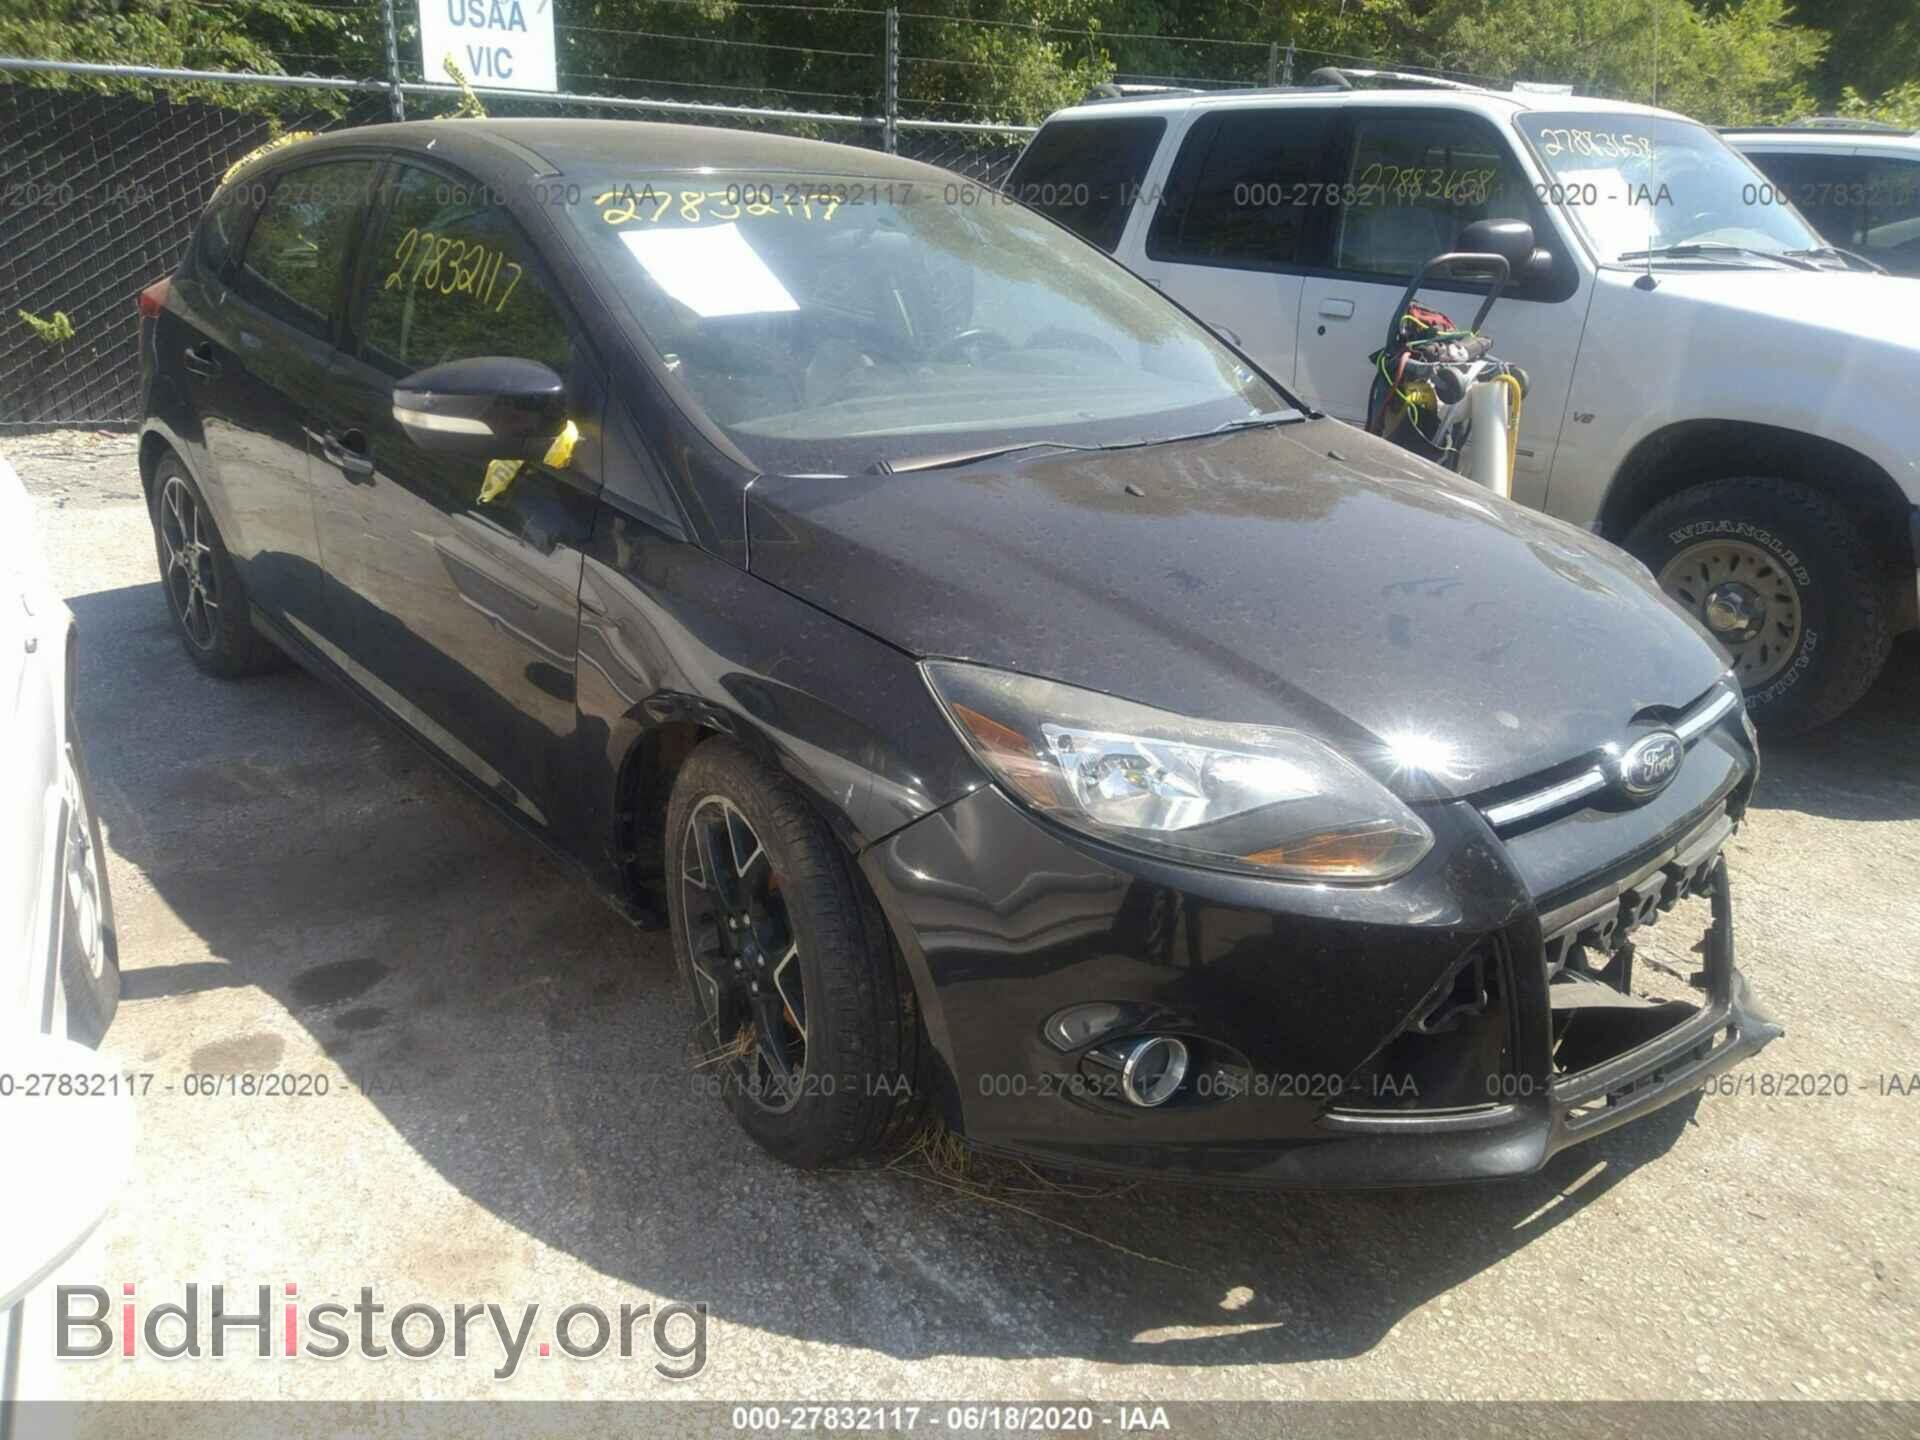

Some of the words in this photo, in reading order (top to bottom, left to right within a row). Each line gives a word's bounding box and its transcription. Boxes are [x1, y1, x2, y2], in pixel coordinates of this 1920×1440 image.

[448, 0, 528, 32] USAA
[467, 45, 513, 79] VIC
[384, 228, 522, 312] 27832117
[1668, 519, 1811, 586] WRANGLER
[1643, 744, 1676, 782] Ford
